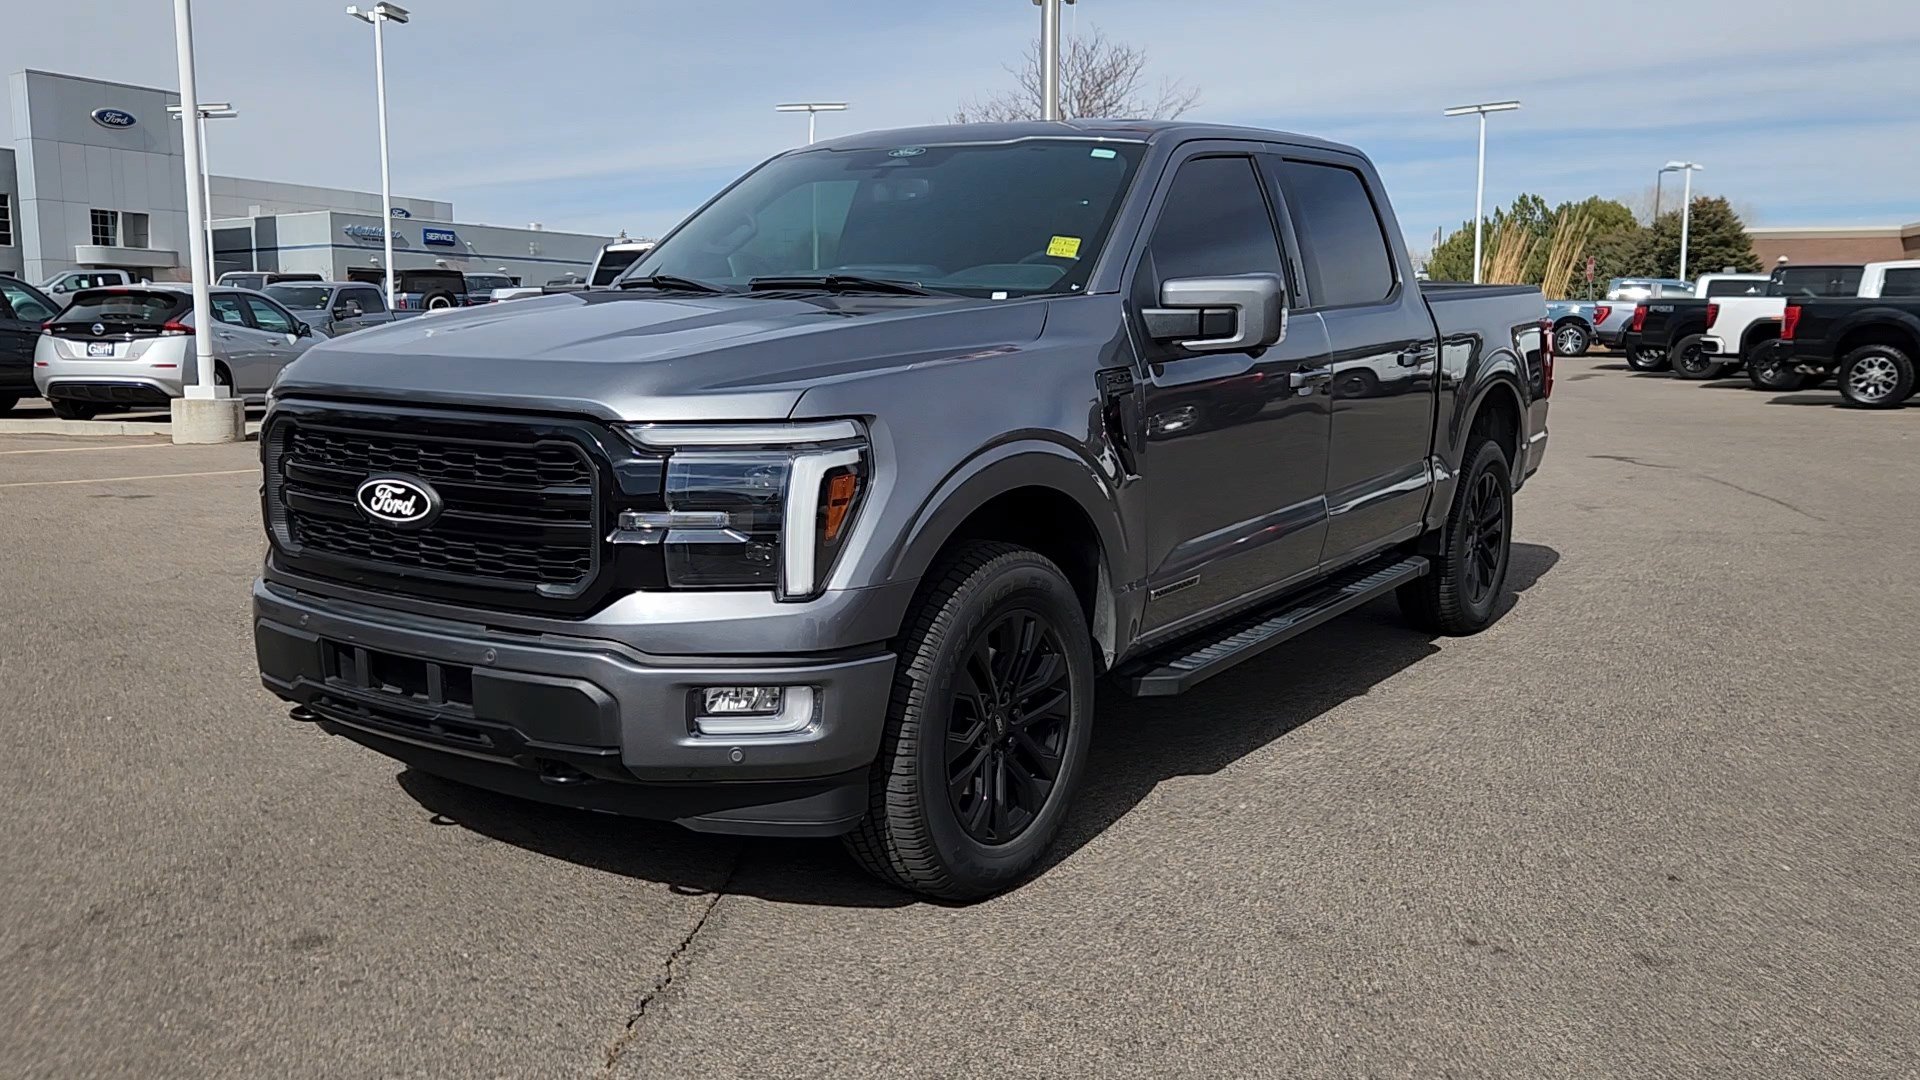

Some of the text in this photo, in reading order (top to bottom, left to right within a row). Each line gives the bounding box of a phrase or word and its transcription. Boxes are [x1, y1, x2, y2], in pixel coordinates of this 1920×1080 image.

[103, 112, 128, 124] Ford
[426, 232, 455, 242] SERVICE
[371, 484, 416, 516] Ford
